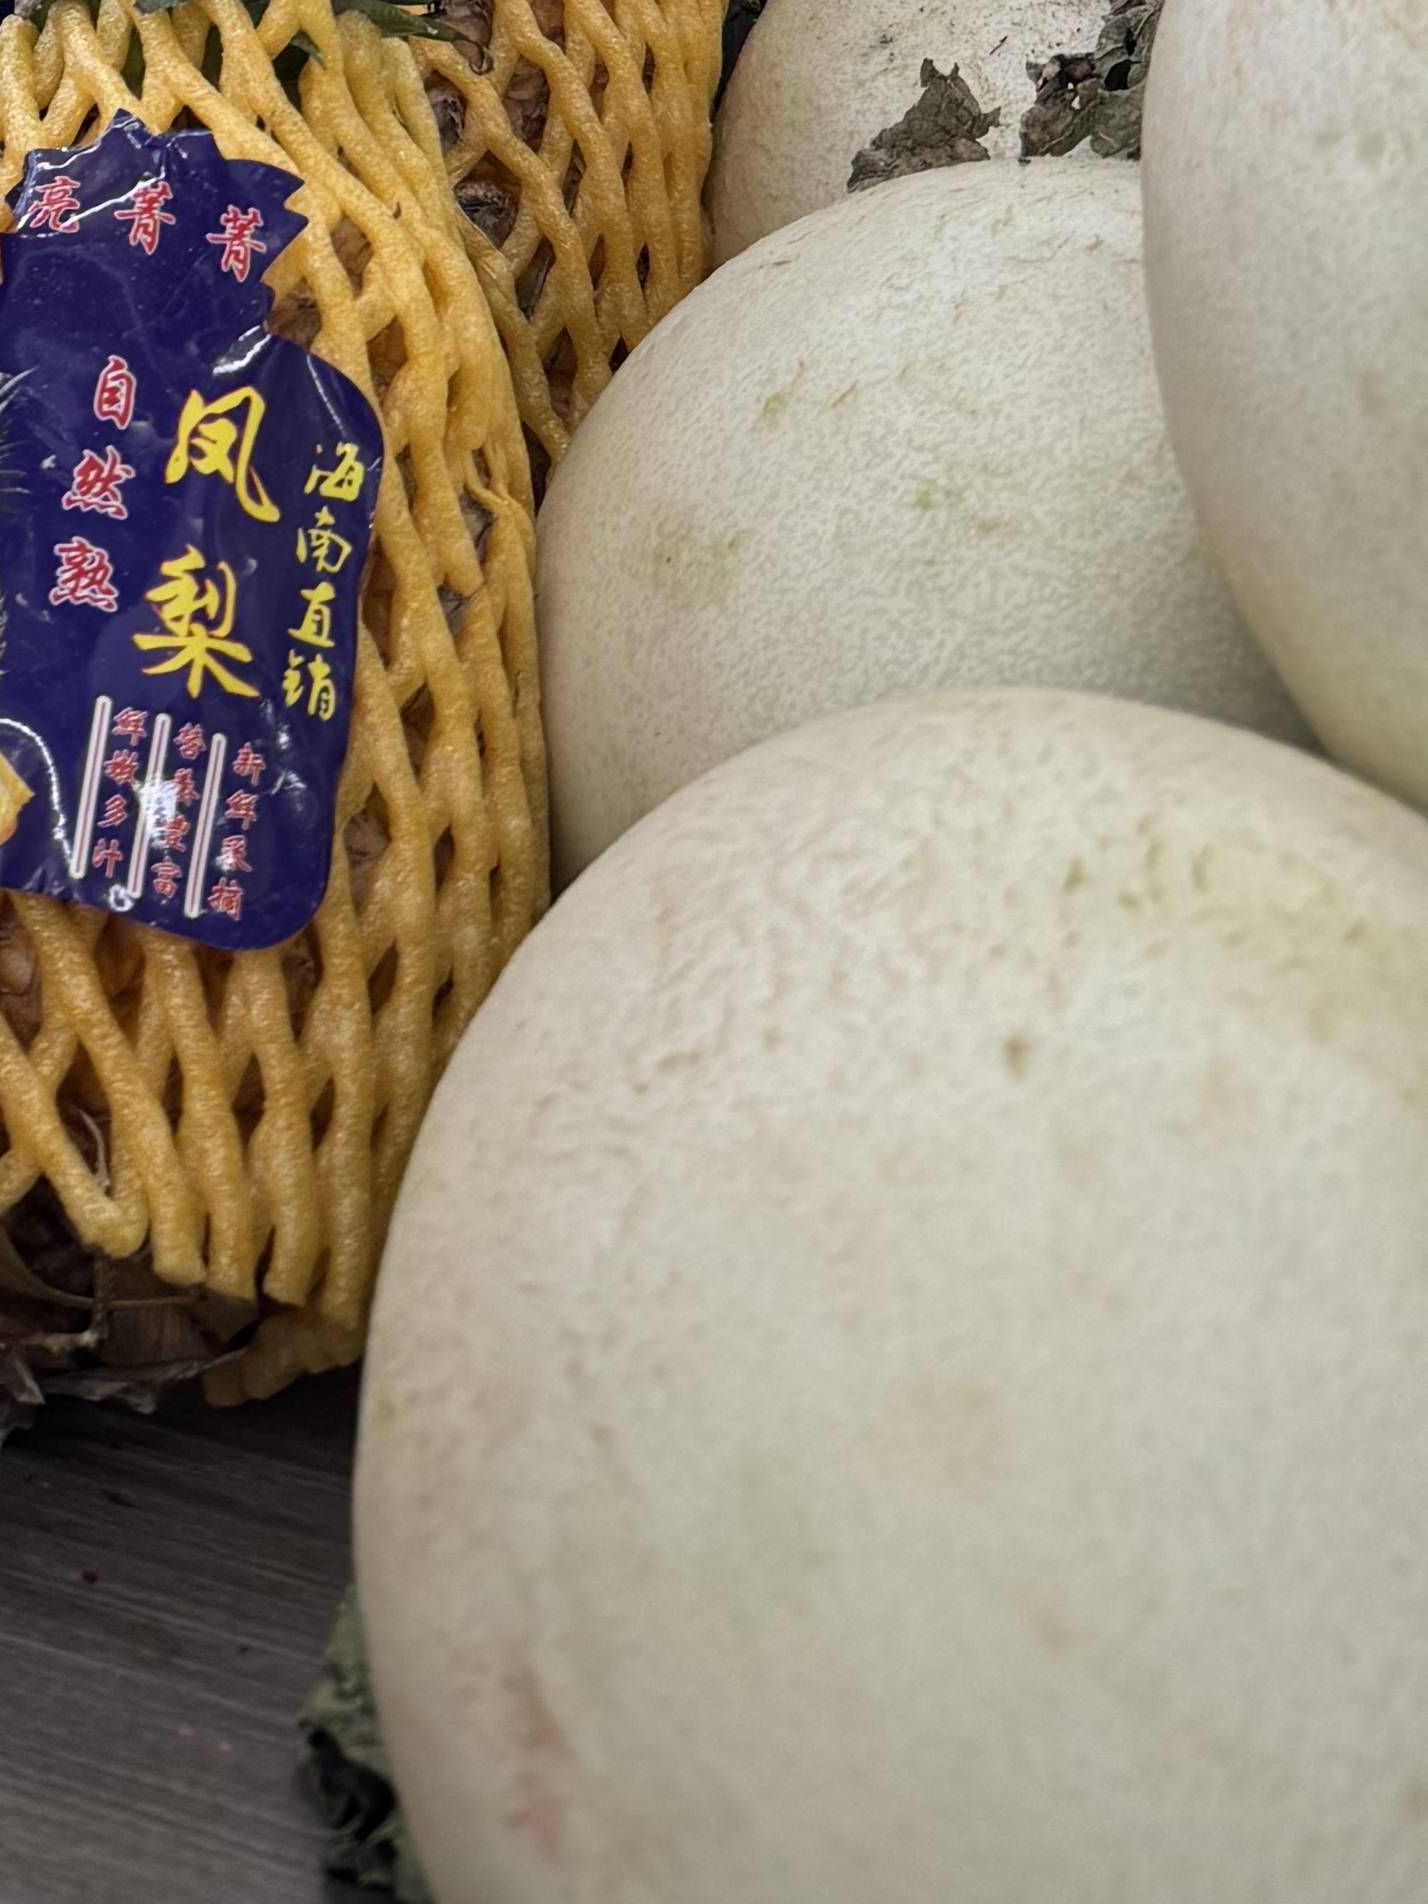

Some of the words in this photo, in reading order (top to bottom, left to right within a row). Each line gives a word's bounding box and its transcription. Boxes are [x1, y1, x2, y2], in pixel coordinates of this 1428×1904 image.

[28, 175, 267, 282] 亮菁菁
[49, 355, 139, 613] 自然熟
[133, 388, 281, 700] 凤梨
[283, 443, 363, 722] 海南直销
